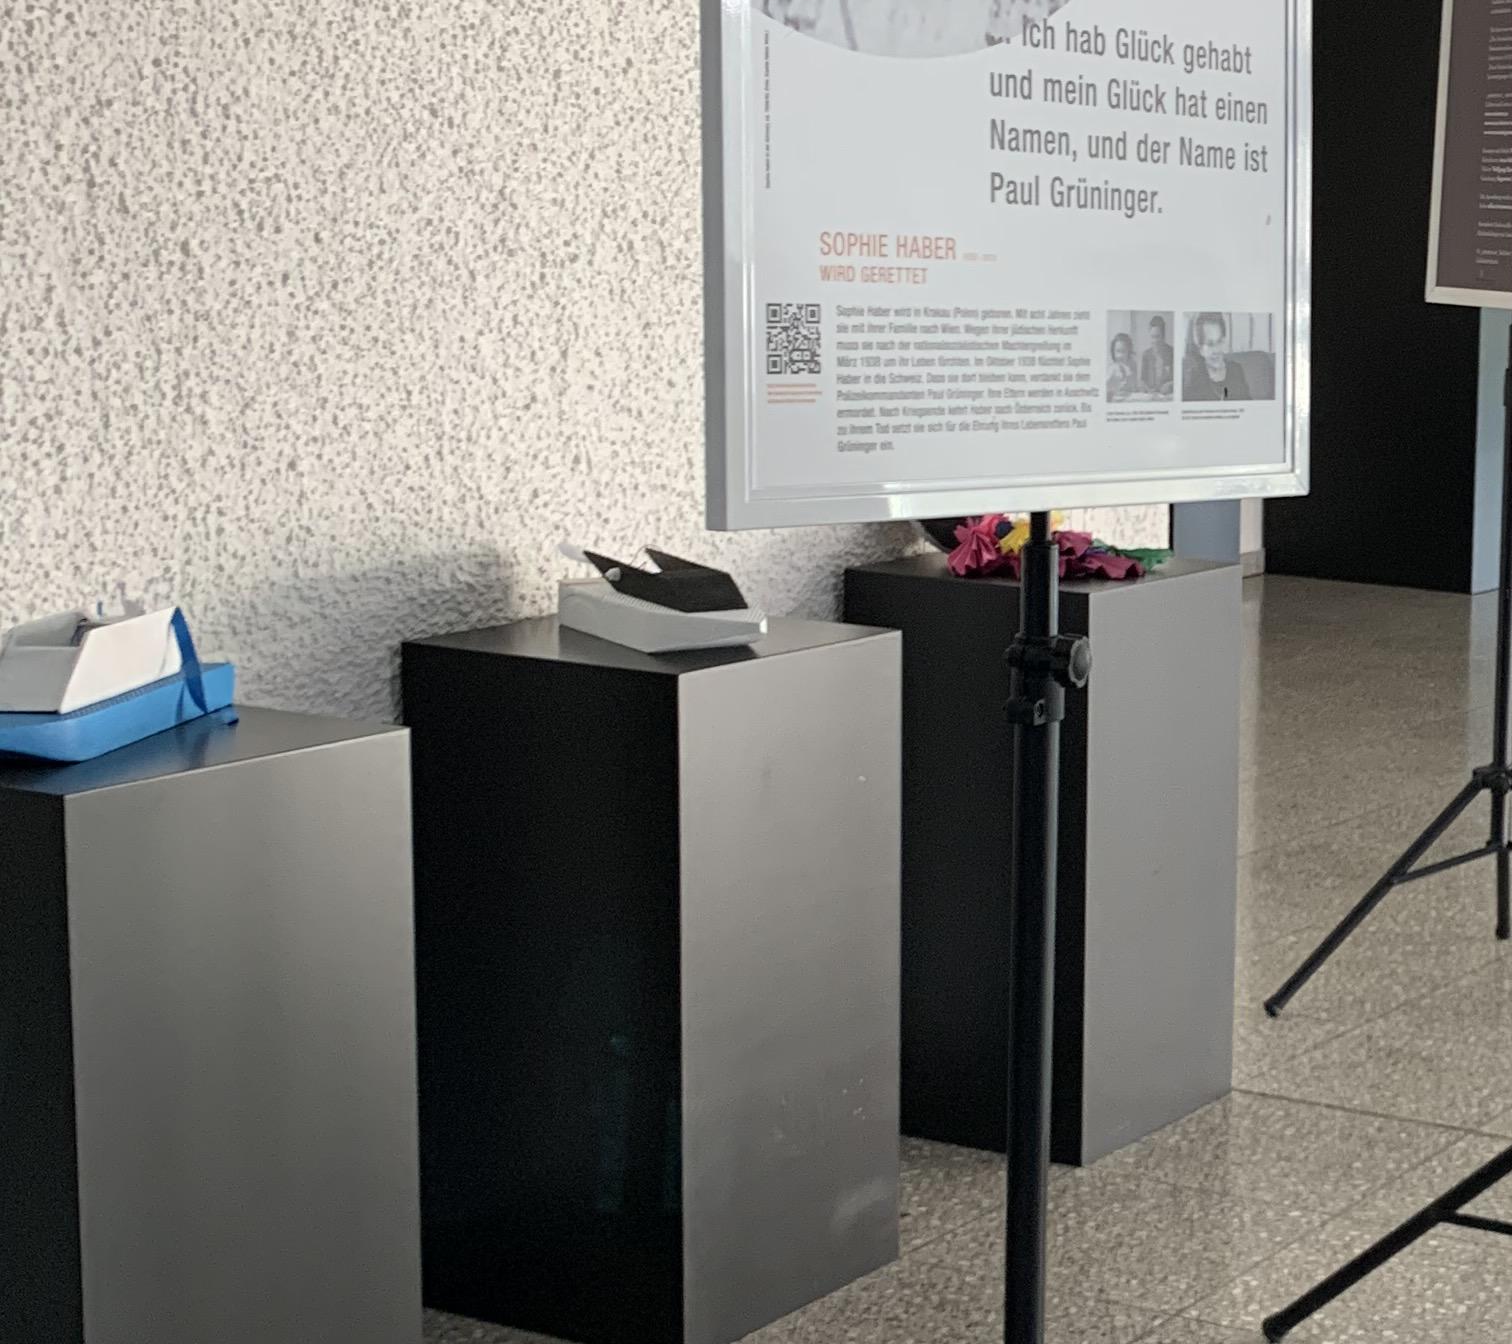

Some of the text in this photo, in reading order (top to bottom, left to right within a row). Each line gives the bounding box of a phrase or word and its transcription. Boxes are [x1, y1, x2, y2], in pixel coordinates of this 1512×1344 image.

[1022, 14, 1055, 50] Ich
[1066, 21, 1106, 57] hab
[1116, 27, 1175, 66] Glück
[1183, 40, 1252, 75] gehabt
[990, 69, 1268, 125] und mein Glück hat einen
[990, 118, 1268, 173] Namen, und der Name ist
[990, 171, 1163, 219] Paul Grüninger.
[819, 231, 957, 260] SOPHIE HABER
[819, 264, 929, 284] WIRD GERETTET
